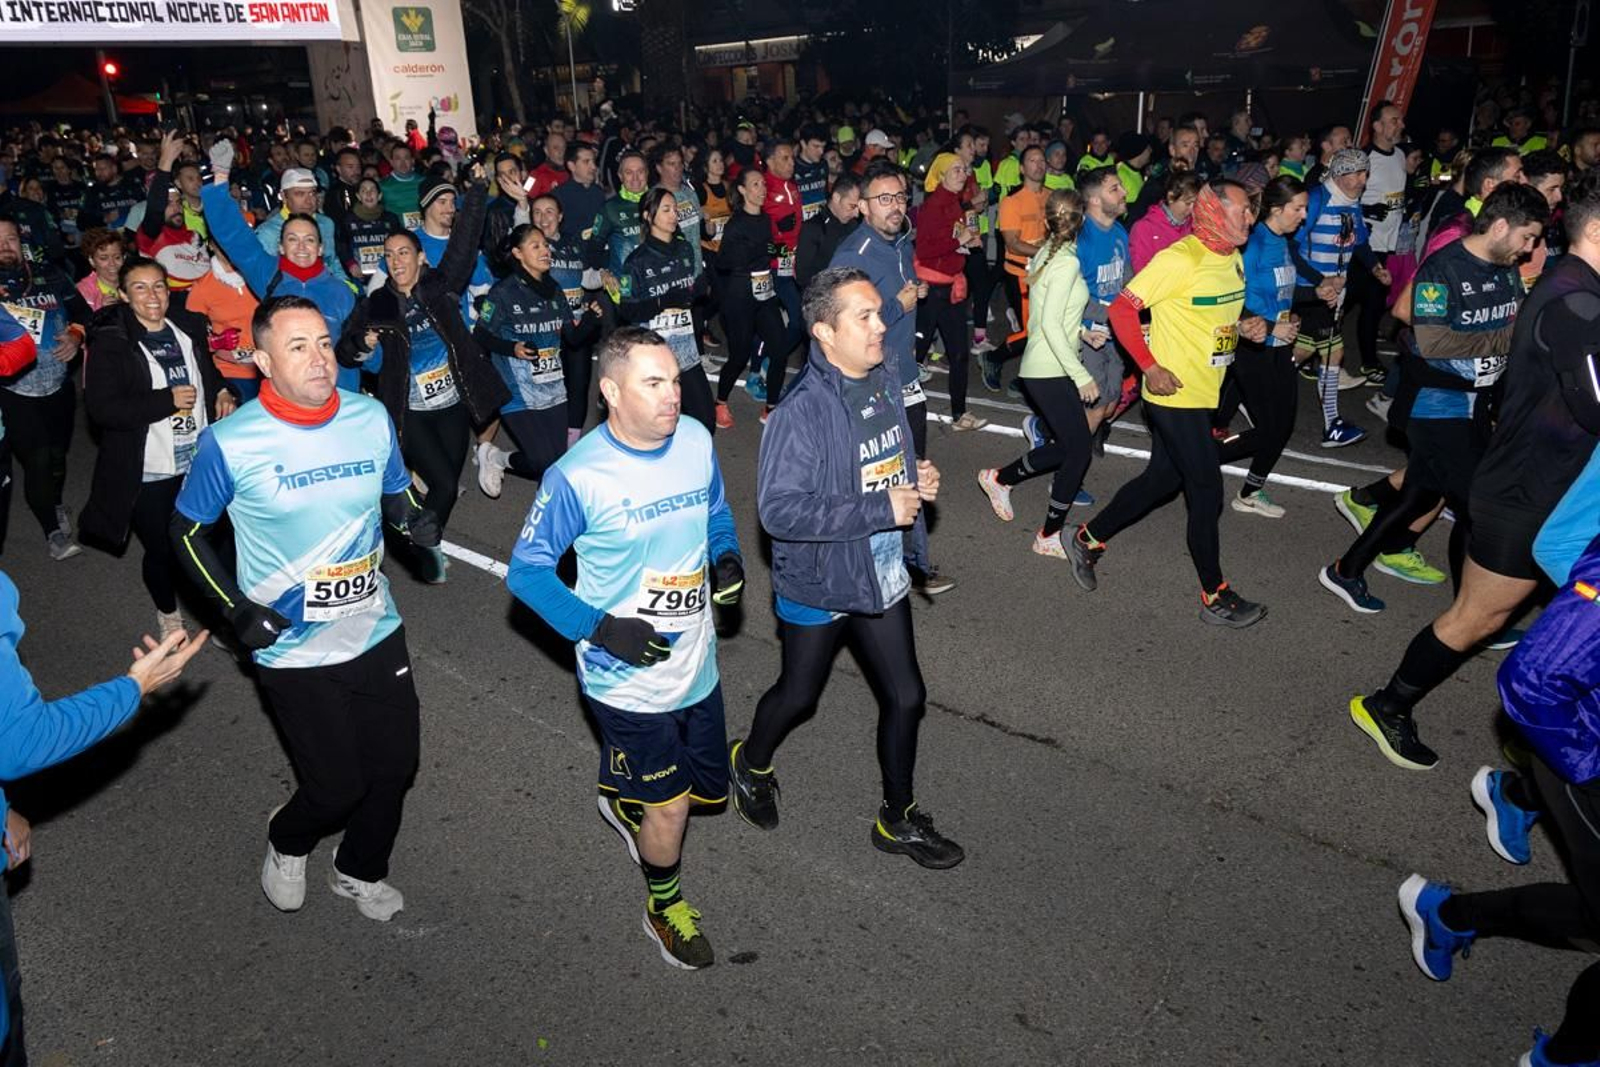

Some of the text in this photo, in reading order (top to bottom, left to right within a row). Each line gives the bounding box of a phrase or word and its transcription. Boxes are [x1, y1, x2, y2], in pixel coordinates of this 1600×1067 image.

[6, 1, 165, 23] INTERNACIONAL
[166, 2, 222, 23] NOCHE
[224, 4, 247, 23] DE
[248, 3, 280, 23] SAN
[649, 284, 670, 297] SAN
[1461, 308, 1490, 325] SAN
[514, 323, 537, 334] SAN
[314, 568, 375, 601] 5092
